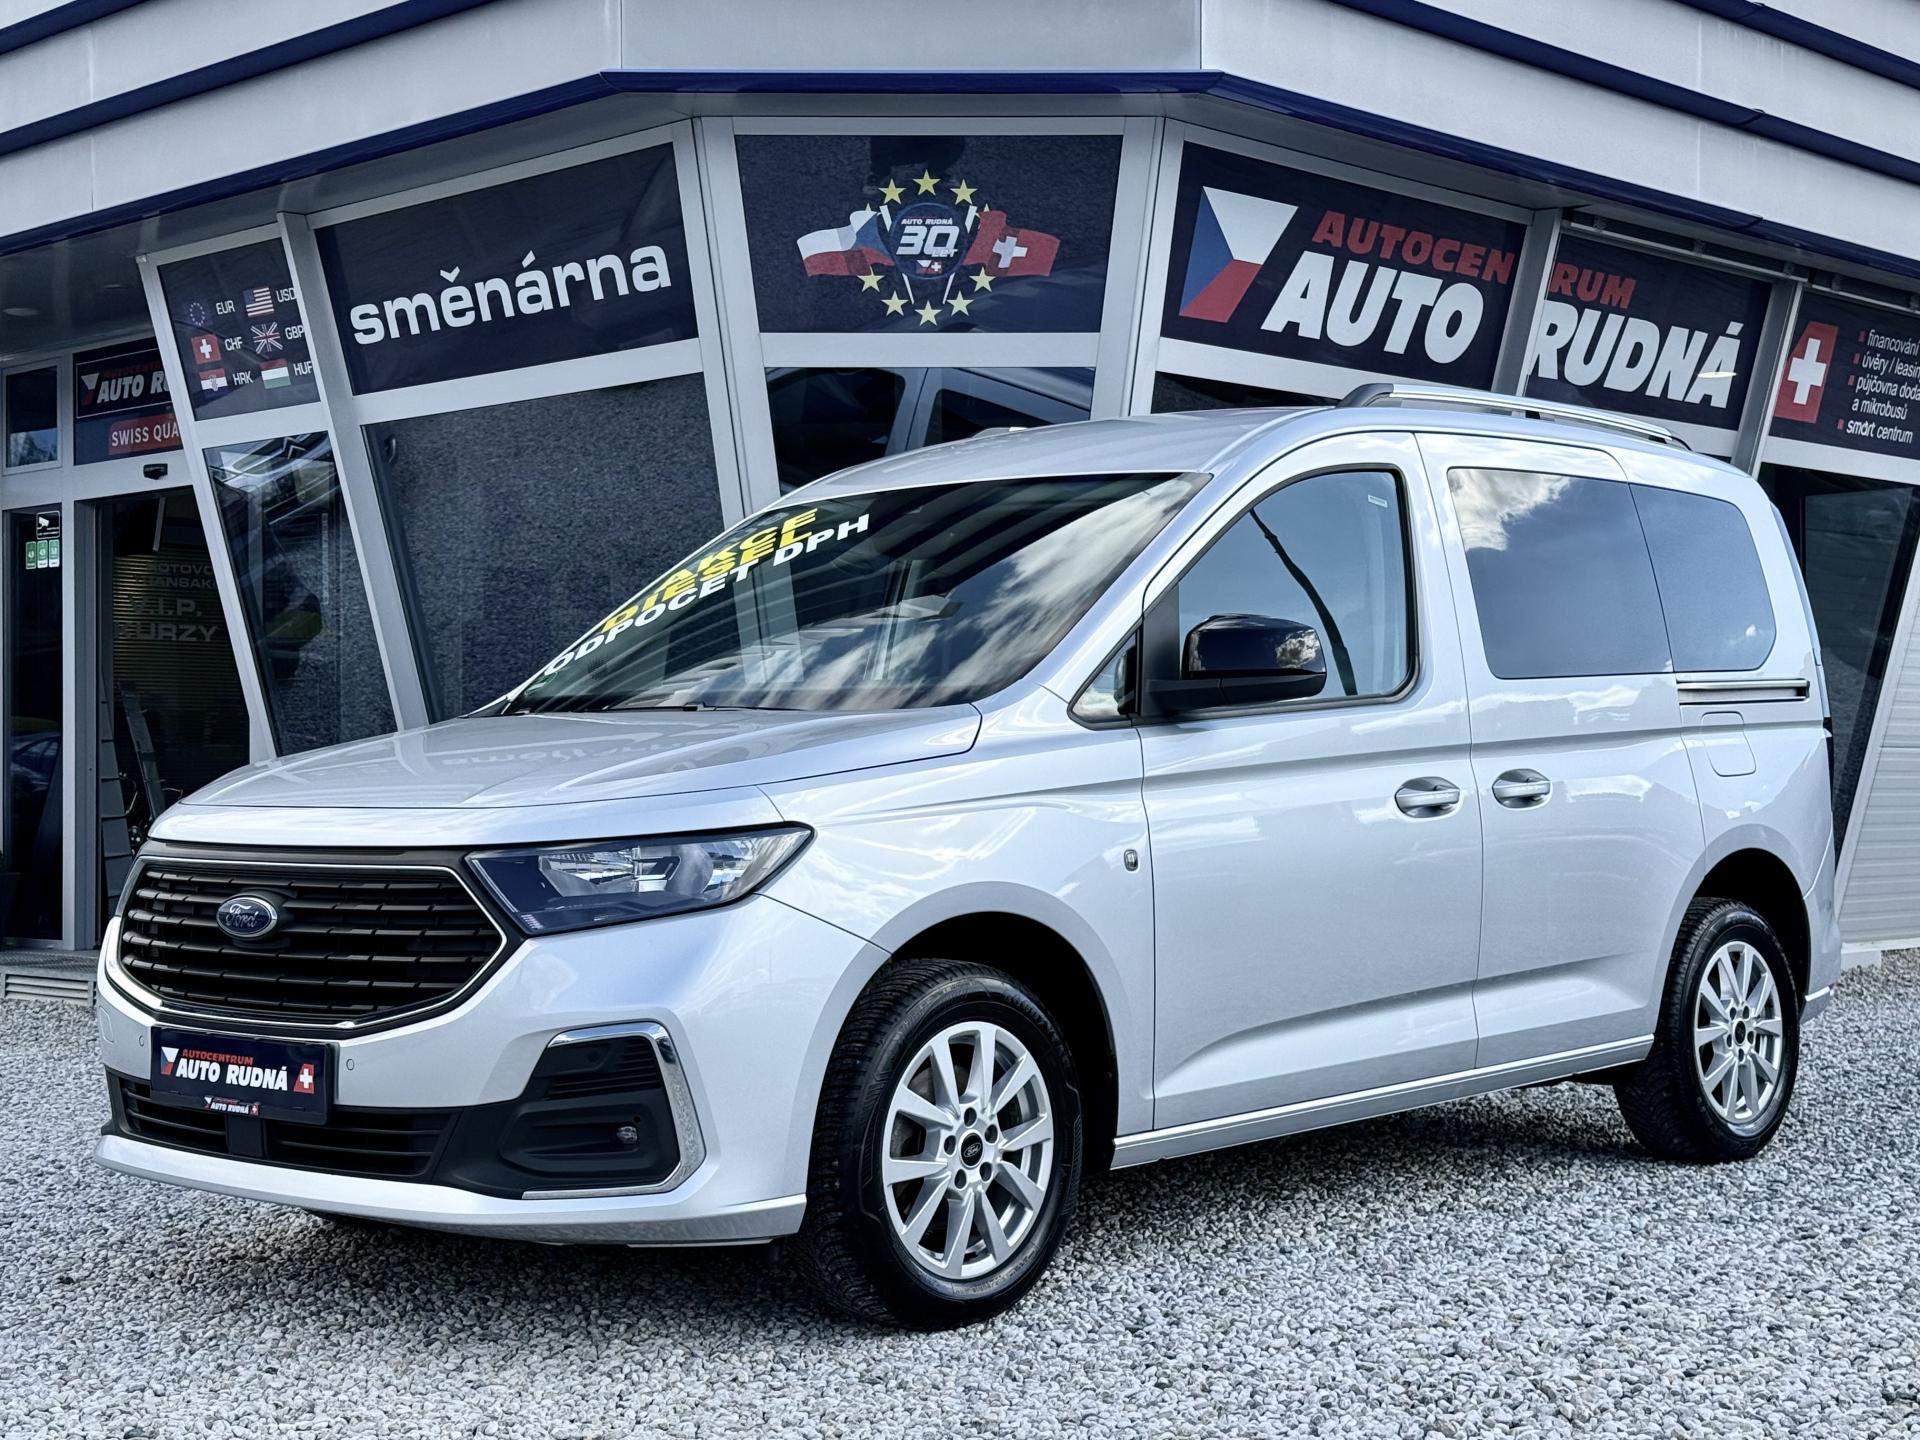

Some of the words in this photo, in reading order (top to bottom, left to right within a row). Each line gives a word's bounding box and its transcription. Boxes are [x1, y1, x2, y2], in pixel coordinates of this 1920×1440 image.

[896, 225, 960, 255] 30
[215, 300, 236, 315] EUR
[276, 287, 297, 303] USD
[350, 245, 672, 345] směnárna
[285, 325, 304, 340] GBP
[1260, 249, 1484, 364] AUTO
[1527, 299, 1743, 409] RUDNÁ
[224, 336, 243, 351] CHF
[1867, 329, 1920, 356] financování
[293, 360, 313, 376] HUF
[1862, 351, 1888, 375] úvěry
[97, 374, 144, 404] AUTO
[232, 370, 254, 386] HRK
[1852, 398, 1859, 411] a
[111, 426, 149, 447] SWISS
[153, 421, 179, 443] QUA
[1846, 420, 1876, 438] smart
[1876, 426, 1913, 444] centrum
[653, 507, 818, 594] AKCE
[773, 513, 870, 566] DPH
[601, 530, 812, 633] DIESEL
[226, 903, 259, 928] Ford
[182, 1048, 254, 1066] AUTOCENTRUM
[175, 1057, 220, 1083] AUTO
[226, 1064, 288, 1091] RUDNÁ
